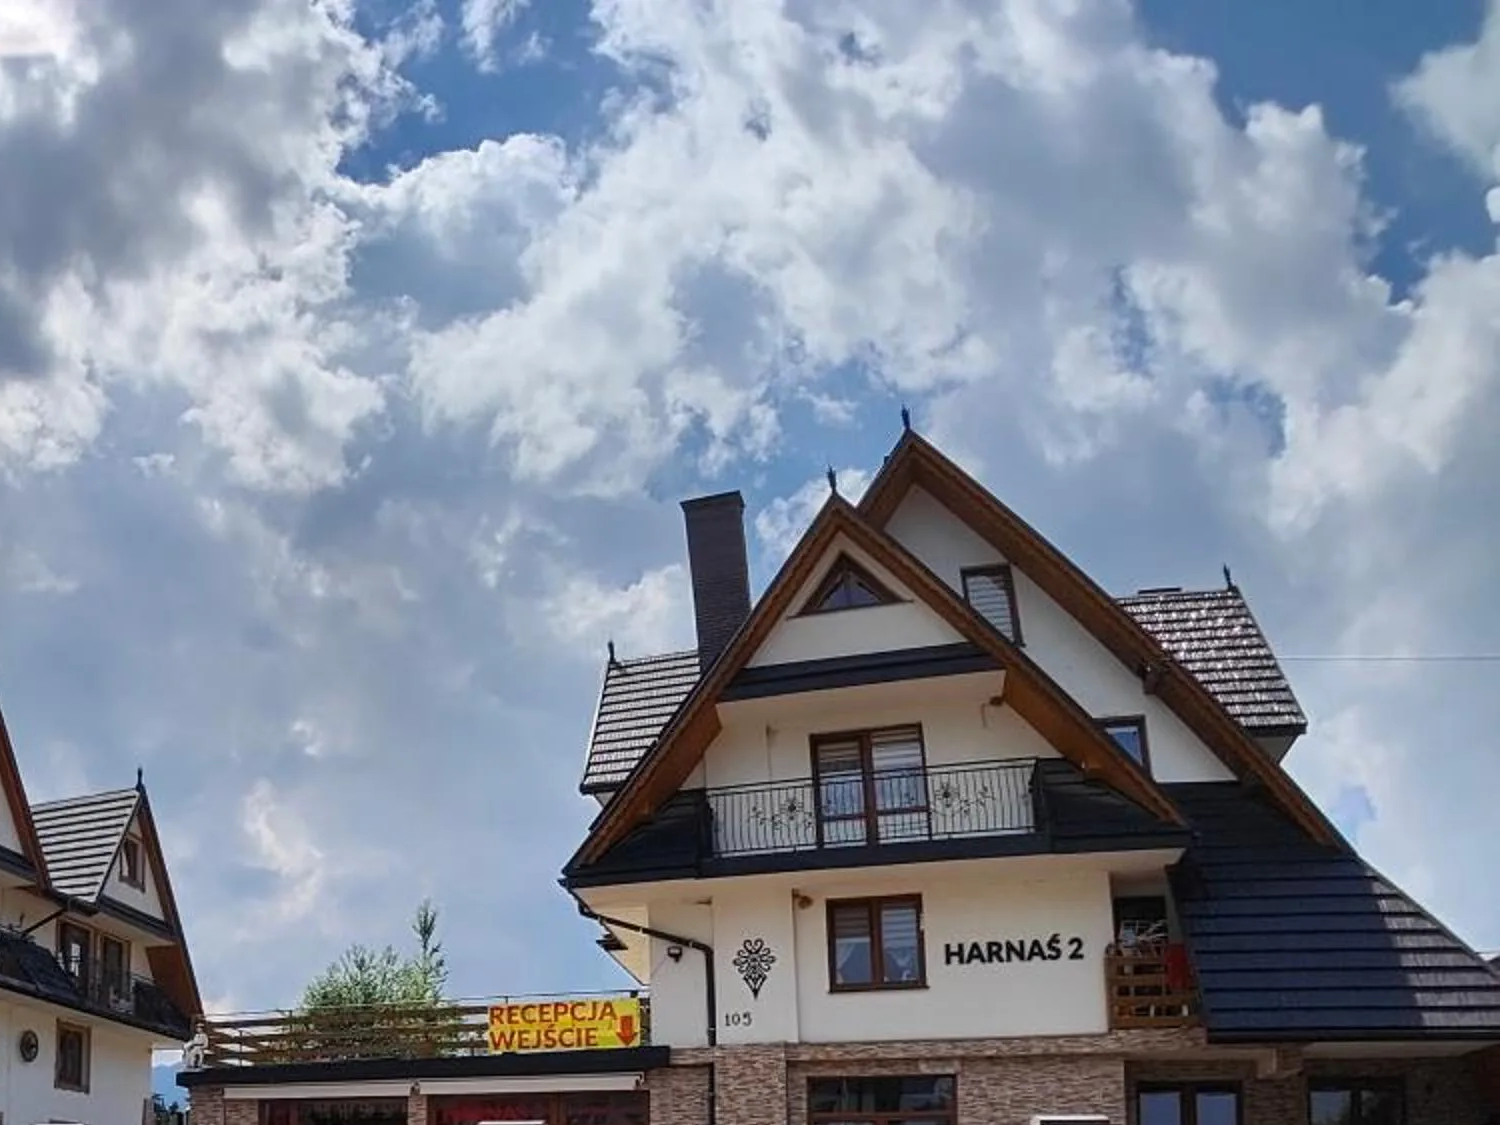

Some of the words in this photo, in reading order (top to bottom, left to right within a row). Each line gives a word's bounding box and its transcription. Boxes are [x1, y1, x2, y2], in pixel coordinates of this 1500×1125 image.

[944, 933, 1062, 965] HARNAŚ
[1068, 937, 1084, 960] 2
[489, 1001, 617, 1026] RECEPCJA
[725, 1011, 752, 1027] 105
[489, 1014, 599, 1050] WEJŚCIE
